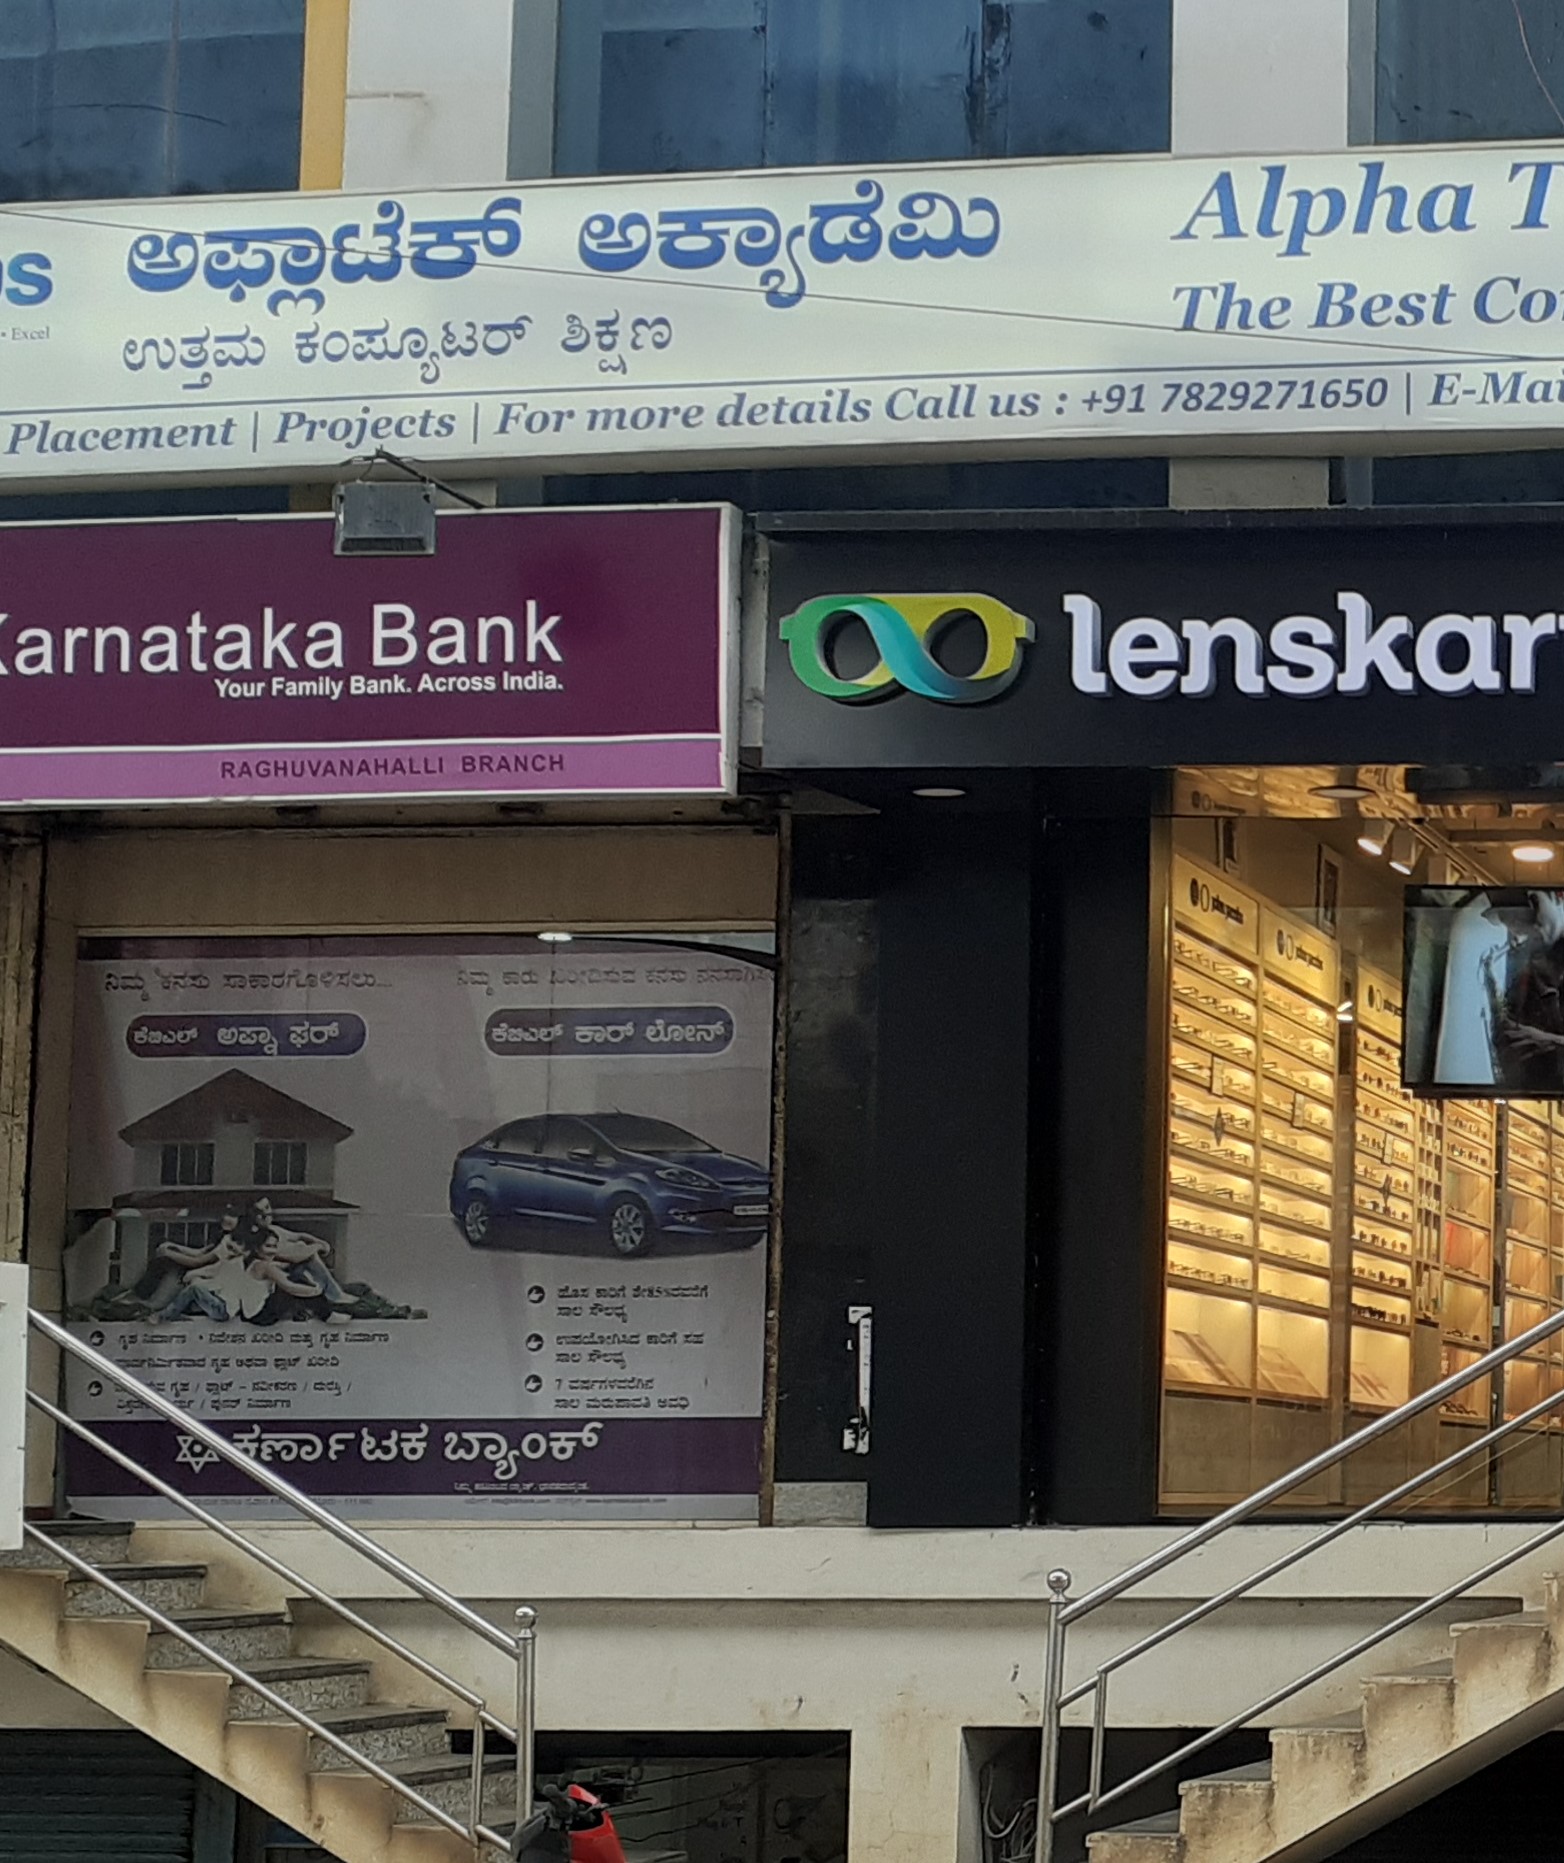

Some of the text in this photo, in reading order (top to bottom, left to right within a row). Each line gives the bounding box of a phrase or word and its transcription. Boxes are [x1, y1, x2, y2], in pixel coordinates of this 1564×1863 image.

[1169, 161, 1477, 258] Alpha
[578, 179, 1001, 308] ಅಕ್ಯಾಡೆಮಿ
[12, 326, 50, 341] Excel
[1172, 281, 1292, 332] The
[1307, 281, 1457, 329] Best
[122, 308, 672, 390] ಉತ್ತಮ ಕಂಪ್ಯೂಟರ್ ಶಿಕ್ಷಣ
[3, 416, 237, 454] Placement
[273, 405, 456, 446] Projects
[495, 402, 575, 434] For
[586, 398, 704, 432] more
[716, 387, 871, 427] details
[885, 384, 977, 420] Call
[989, 391, 1040, 417] us
[1081, 384, 1146, 414] +91
[1159, 376, 1388, 412] 7829271650
[0, 600, 564, 677] arnataka Bank
[214, 671, 564, 700] Your Family Bank. Across India.
[220, 753, 564, 780] RAGHUVANAHALLI BRANCH
[444, 1422, 603, 1480] ಬ್ಯಾಂಕ್
